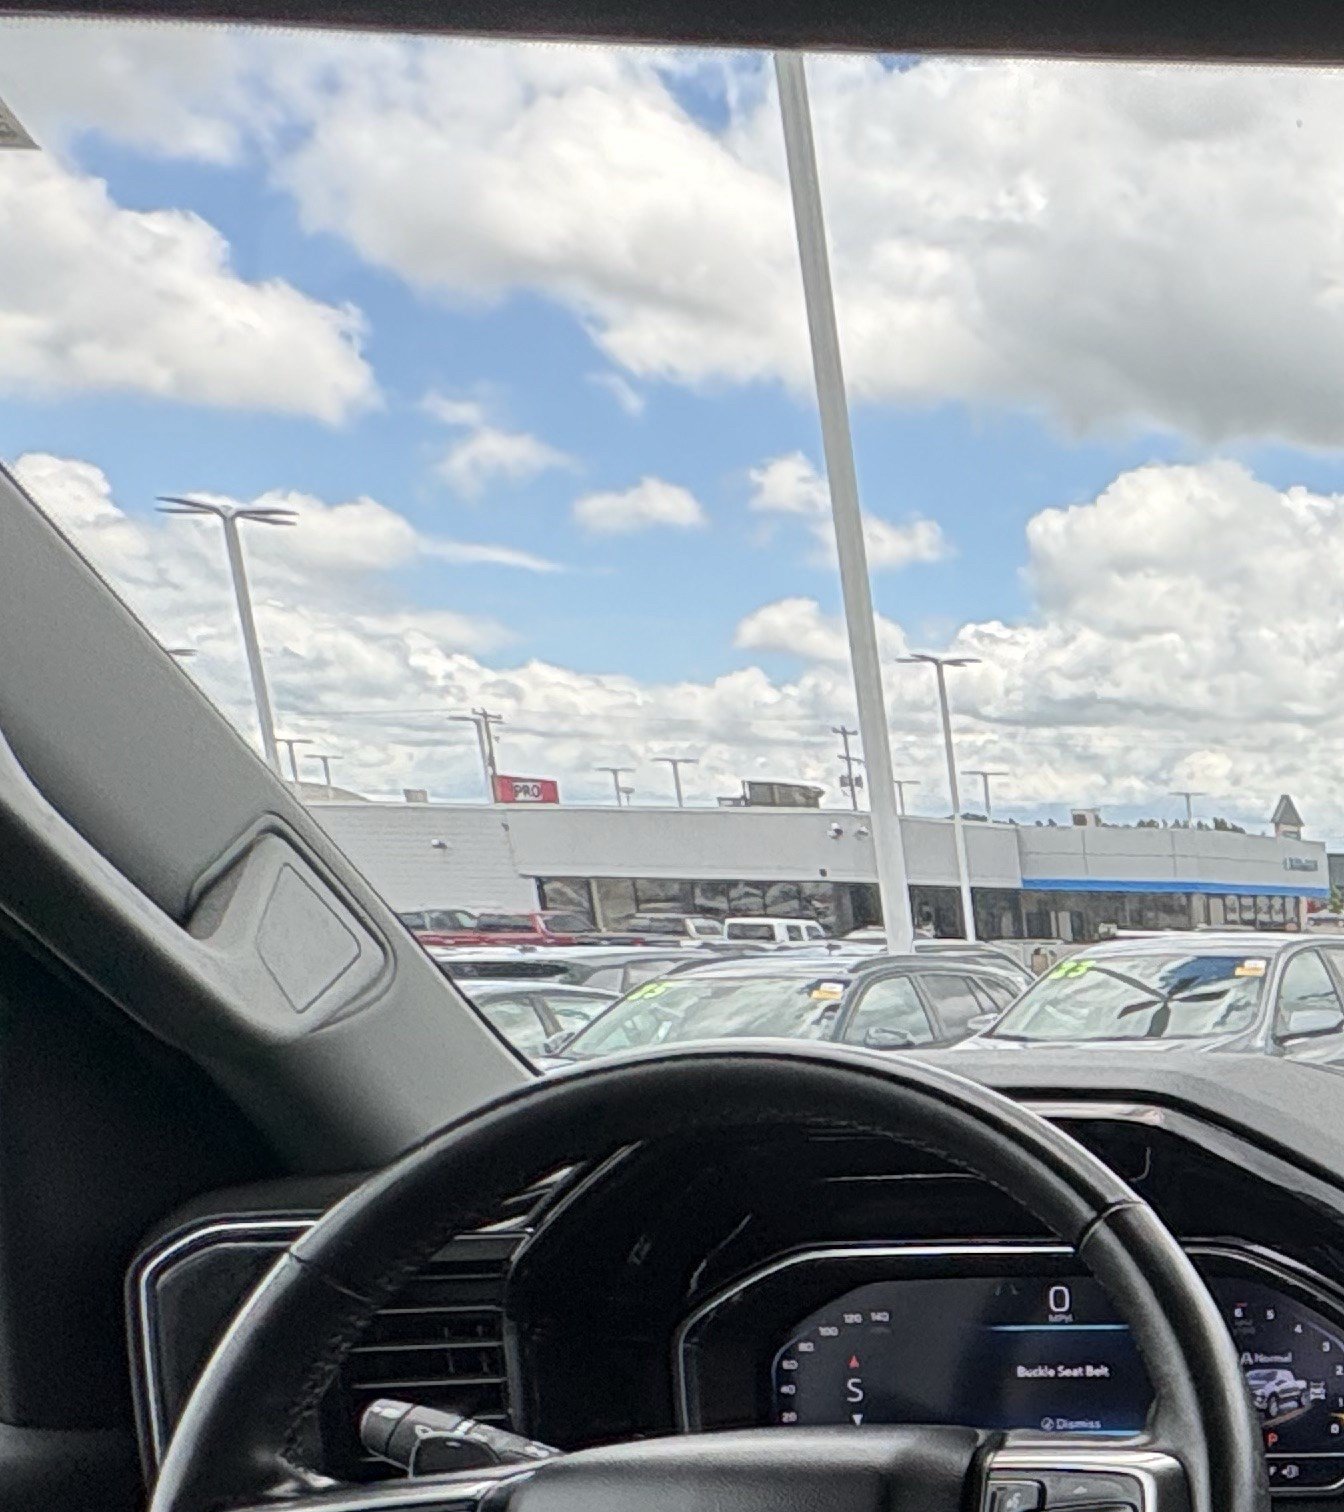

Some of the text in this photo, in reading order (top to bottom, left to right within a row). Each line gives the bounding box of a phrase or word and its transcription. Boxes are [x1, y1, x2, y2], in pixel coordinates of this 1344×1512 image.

[1049, 1285, 1071, 1313] 0
[1016, 1365, 1110, 1378] Buckle Seat Belt
[1056, 1418, 1102, 1430] Dismiss
